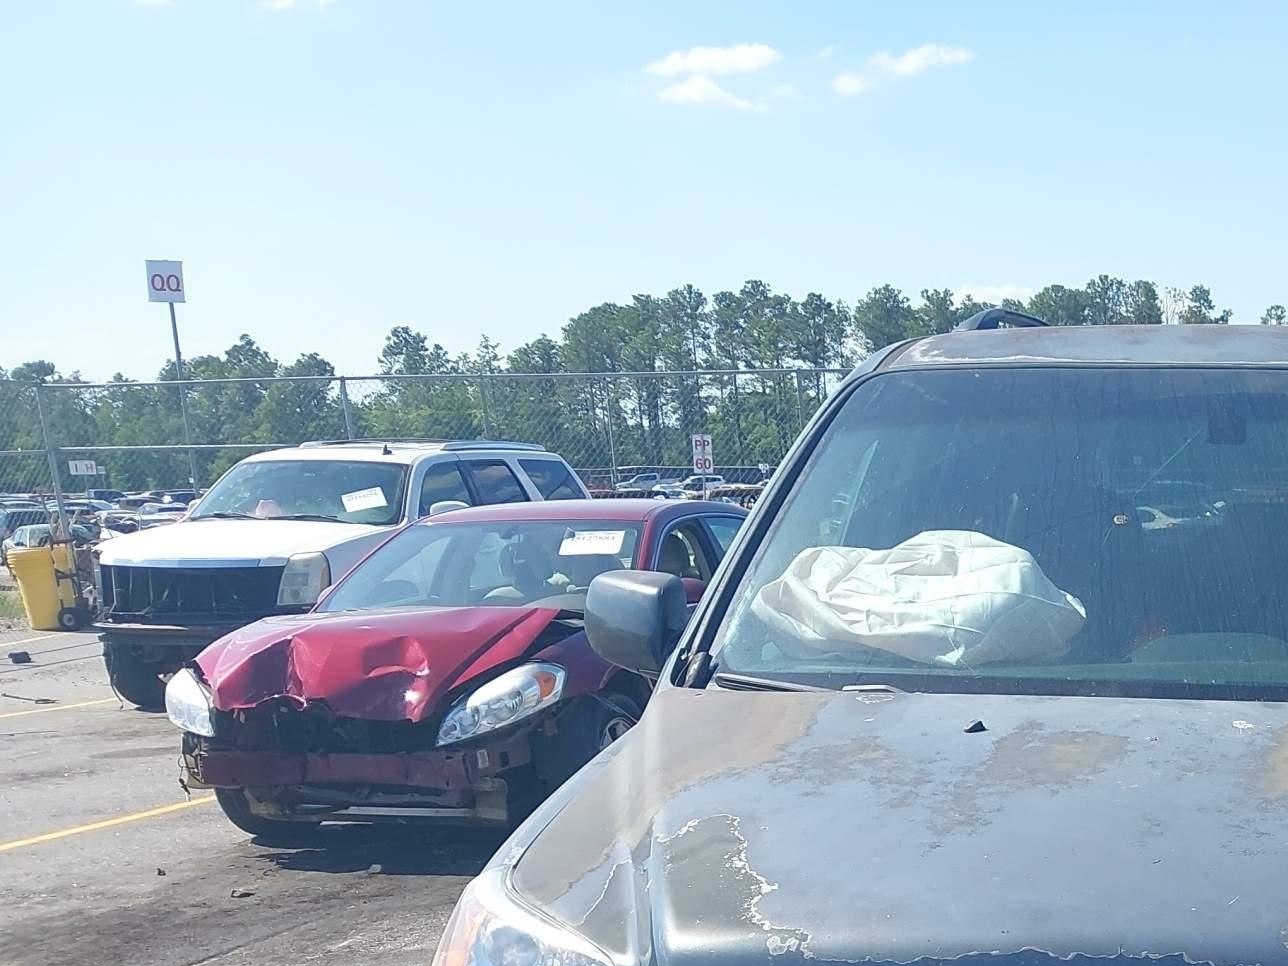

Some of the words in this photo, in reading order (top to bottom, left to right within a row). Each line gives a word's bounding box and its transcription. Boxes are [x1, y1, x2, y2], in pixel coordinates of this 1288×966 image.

[151, 273, 182, 292] QQ
[694, 439, 710, 451] PP
[695, 457, 712, 470] 60
